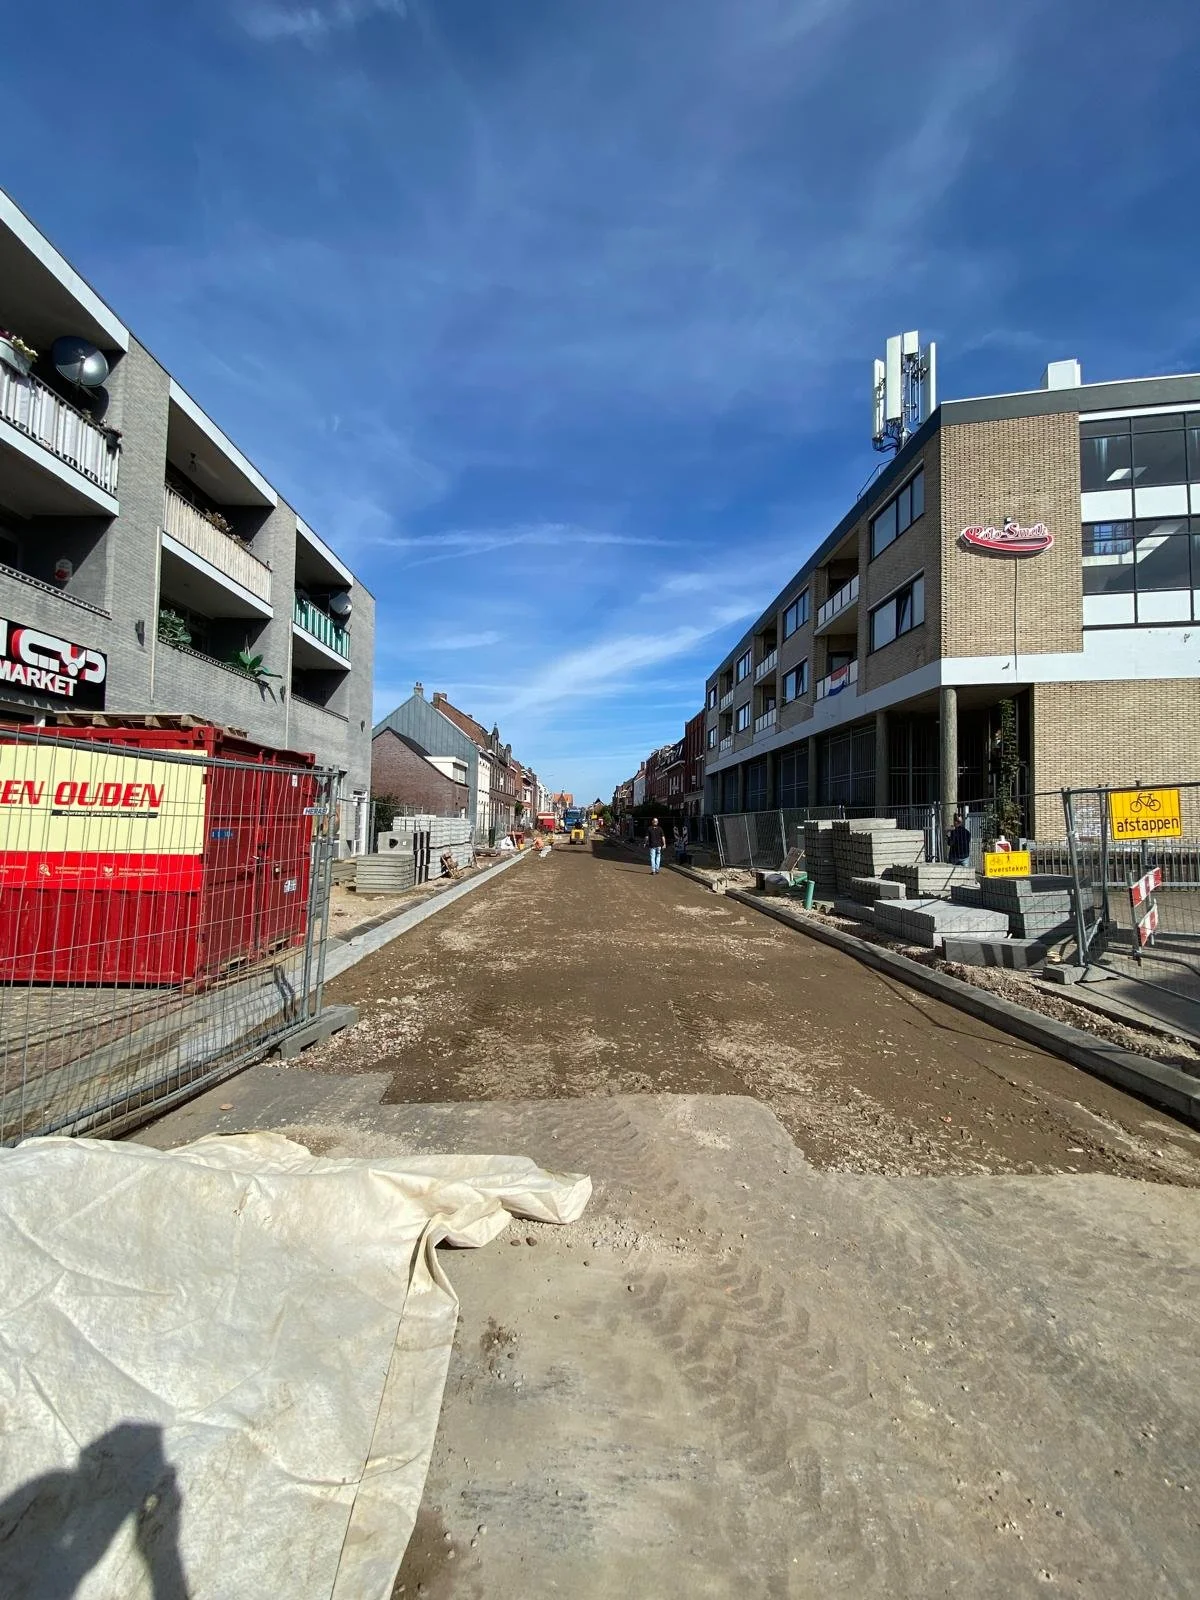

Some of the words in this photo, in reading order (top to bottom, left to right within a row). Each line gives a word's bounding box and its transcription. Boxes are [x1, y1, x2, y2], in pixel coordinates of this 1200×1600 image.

[0, 780, 45, 805] EN
[54, 782, 165, 808] OUDEN
[1117, 818, 1179, 833] afstappen
[989, 865, 1028, 873] oversteken
